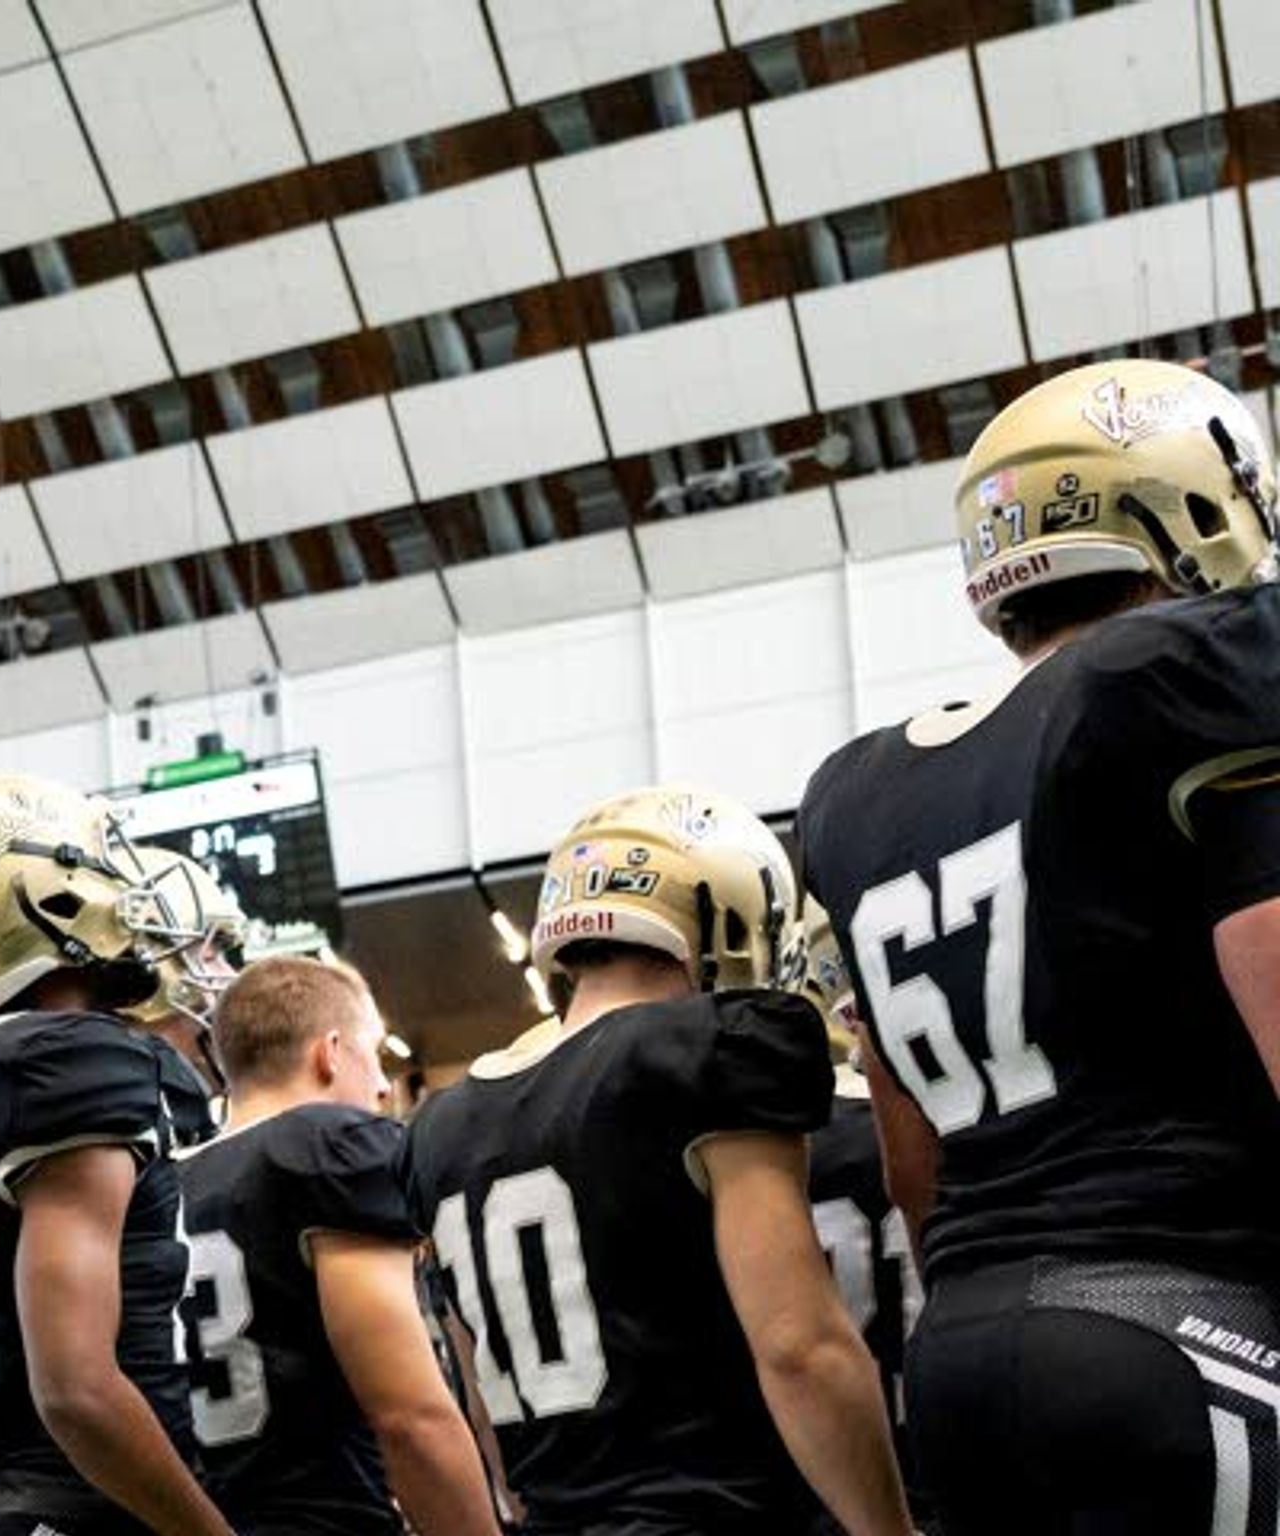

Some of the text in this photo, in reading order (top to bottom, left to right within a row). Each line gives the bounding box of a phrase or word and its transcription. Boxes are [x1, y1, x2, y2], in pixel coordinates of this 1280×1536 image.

[851, 819, 1058, 1138] 67
[431, 1164, 611, 1427] 10
[1175, 1314, 1280, 1369] VANDALS
